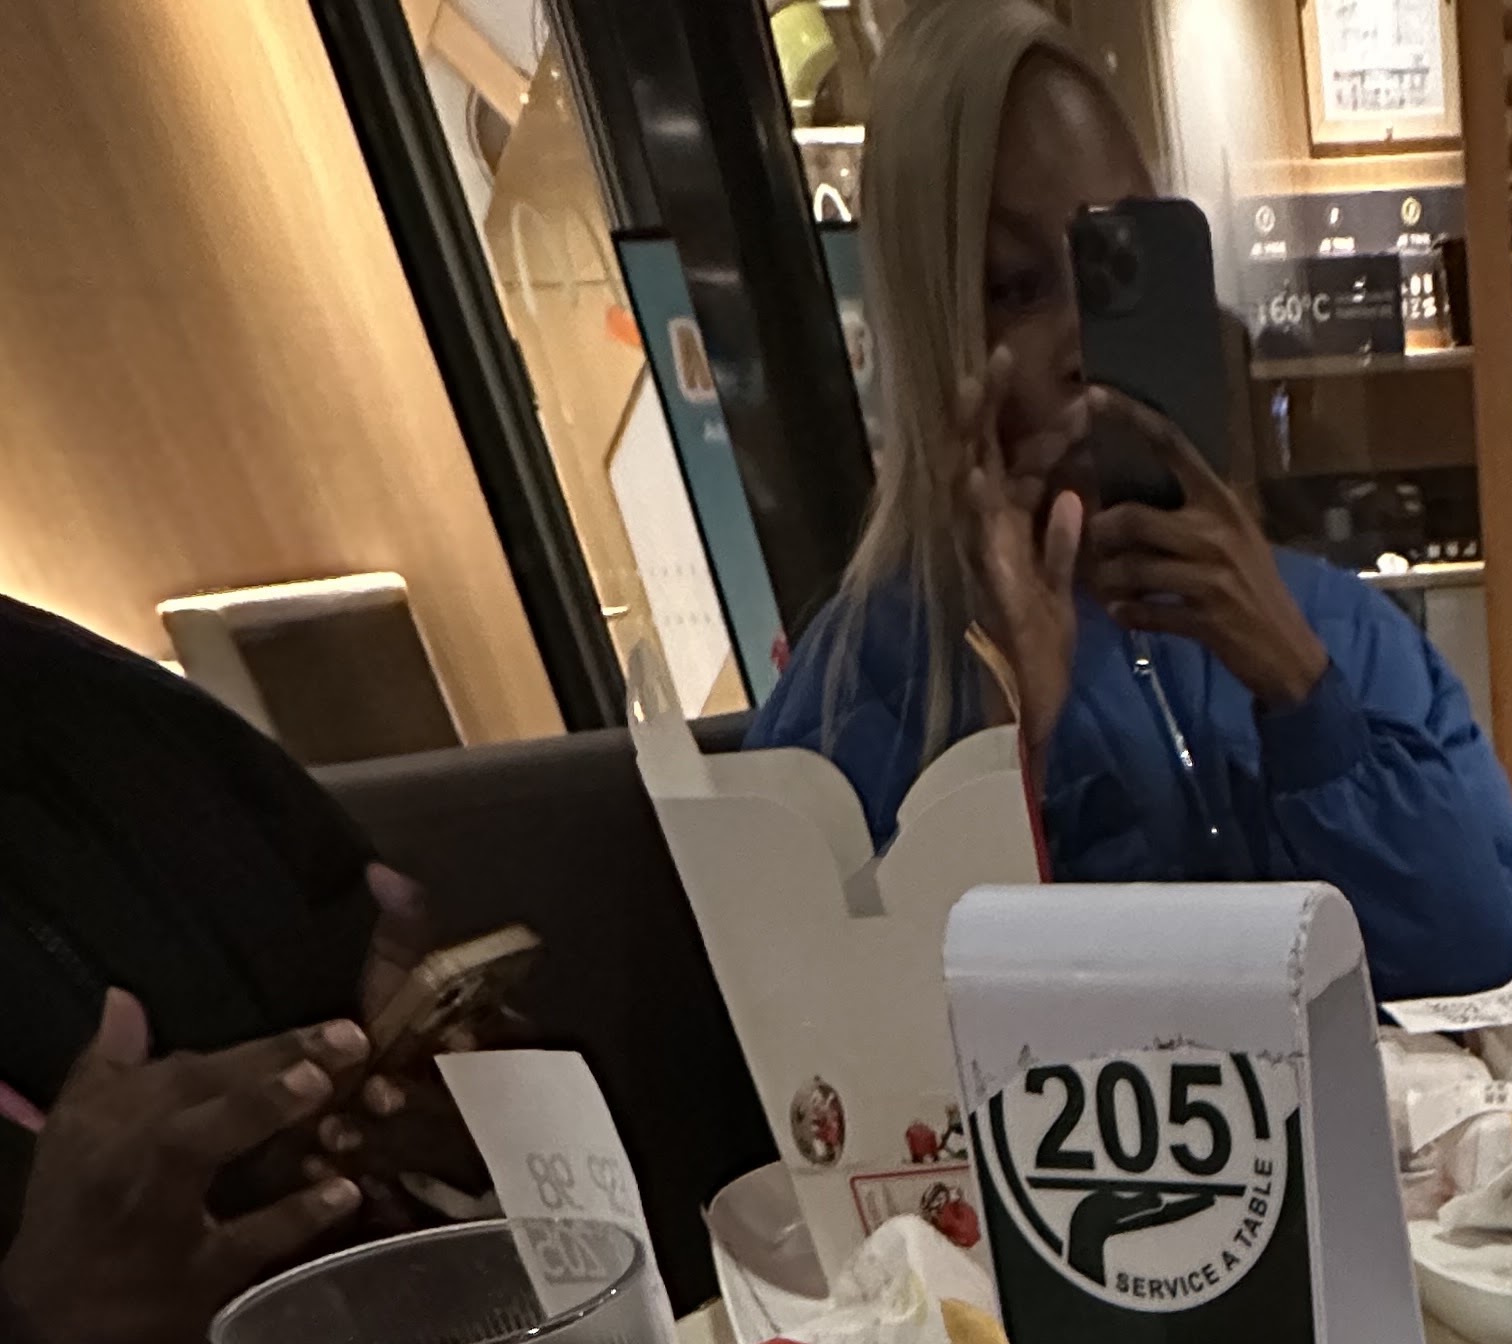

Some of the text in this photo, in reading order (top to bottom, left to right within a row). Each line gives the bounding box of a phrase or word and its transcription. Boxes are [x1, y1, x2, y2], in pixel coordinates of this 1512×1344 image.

[1024, 1060, 1232, 1176] 205
[1116, 1158, 1273, 1299] SERVICE A TABLE
